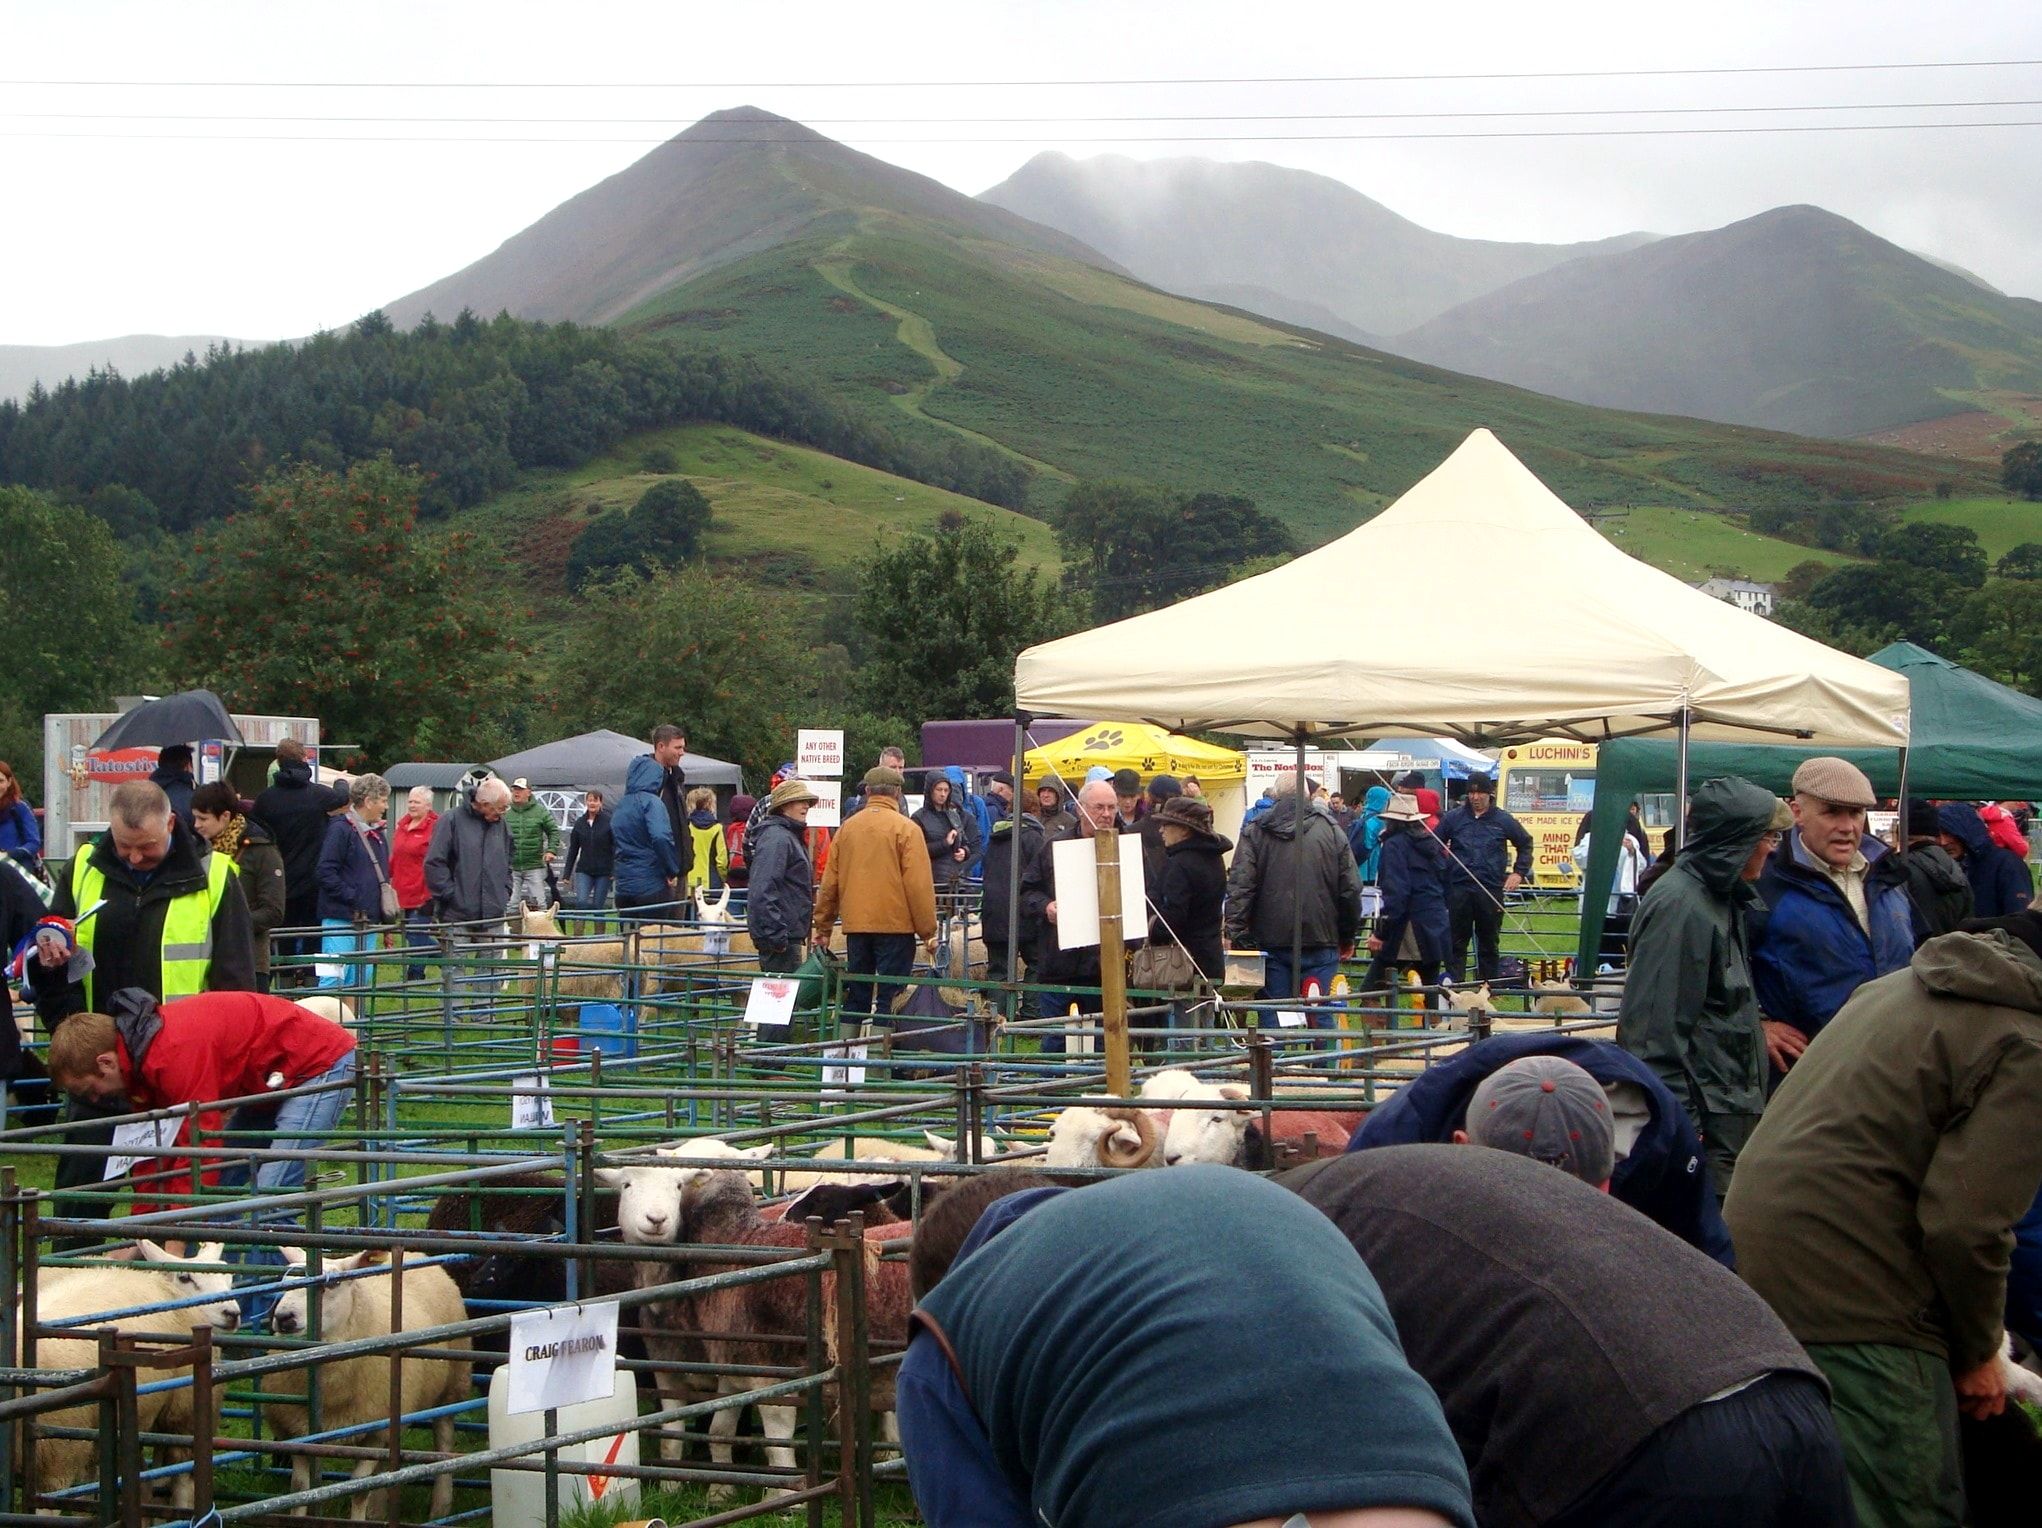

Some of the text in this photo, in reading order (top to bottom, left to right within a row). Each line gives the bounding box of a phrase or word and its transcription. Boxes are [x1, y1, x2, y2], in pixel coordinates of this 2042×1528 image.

[805, 742, 837, 751] ANY OTHER
[1529, 747, 1591, 760] LUCHINI'S
[801, 754, 841, 764] NATIVE BREED
[1251, 763, 1273, 772] The
[1304, 763, 1325, 772] Box
[1518, 816, 1534, 825] OME
[1536, 816, 1558, 825] MADE
[1560, 816, 1573, 825] ICE
[1542, 833, 1571, 843] MIND
[1543, 844, 1569, 853] THAT
[1539, 855, 1573, 865] CHILD!
[525, 1334, 606, 1361] CRAIG FEARON
